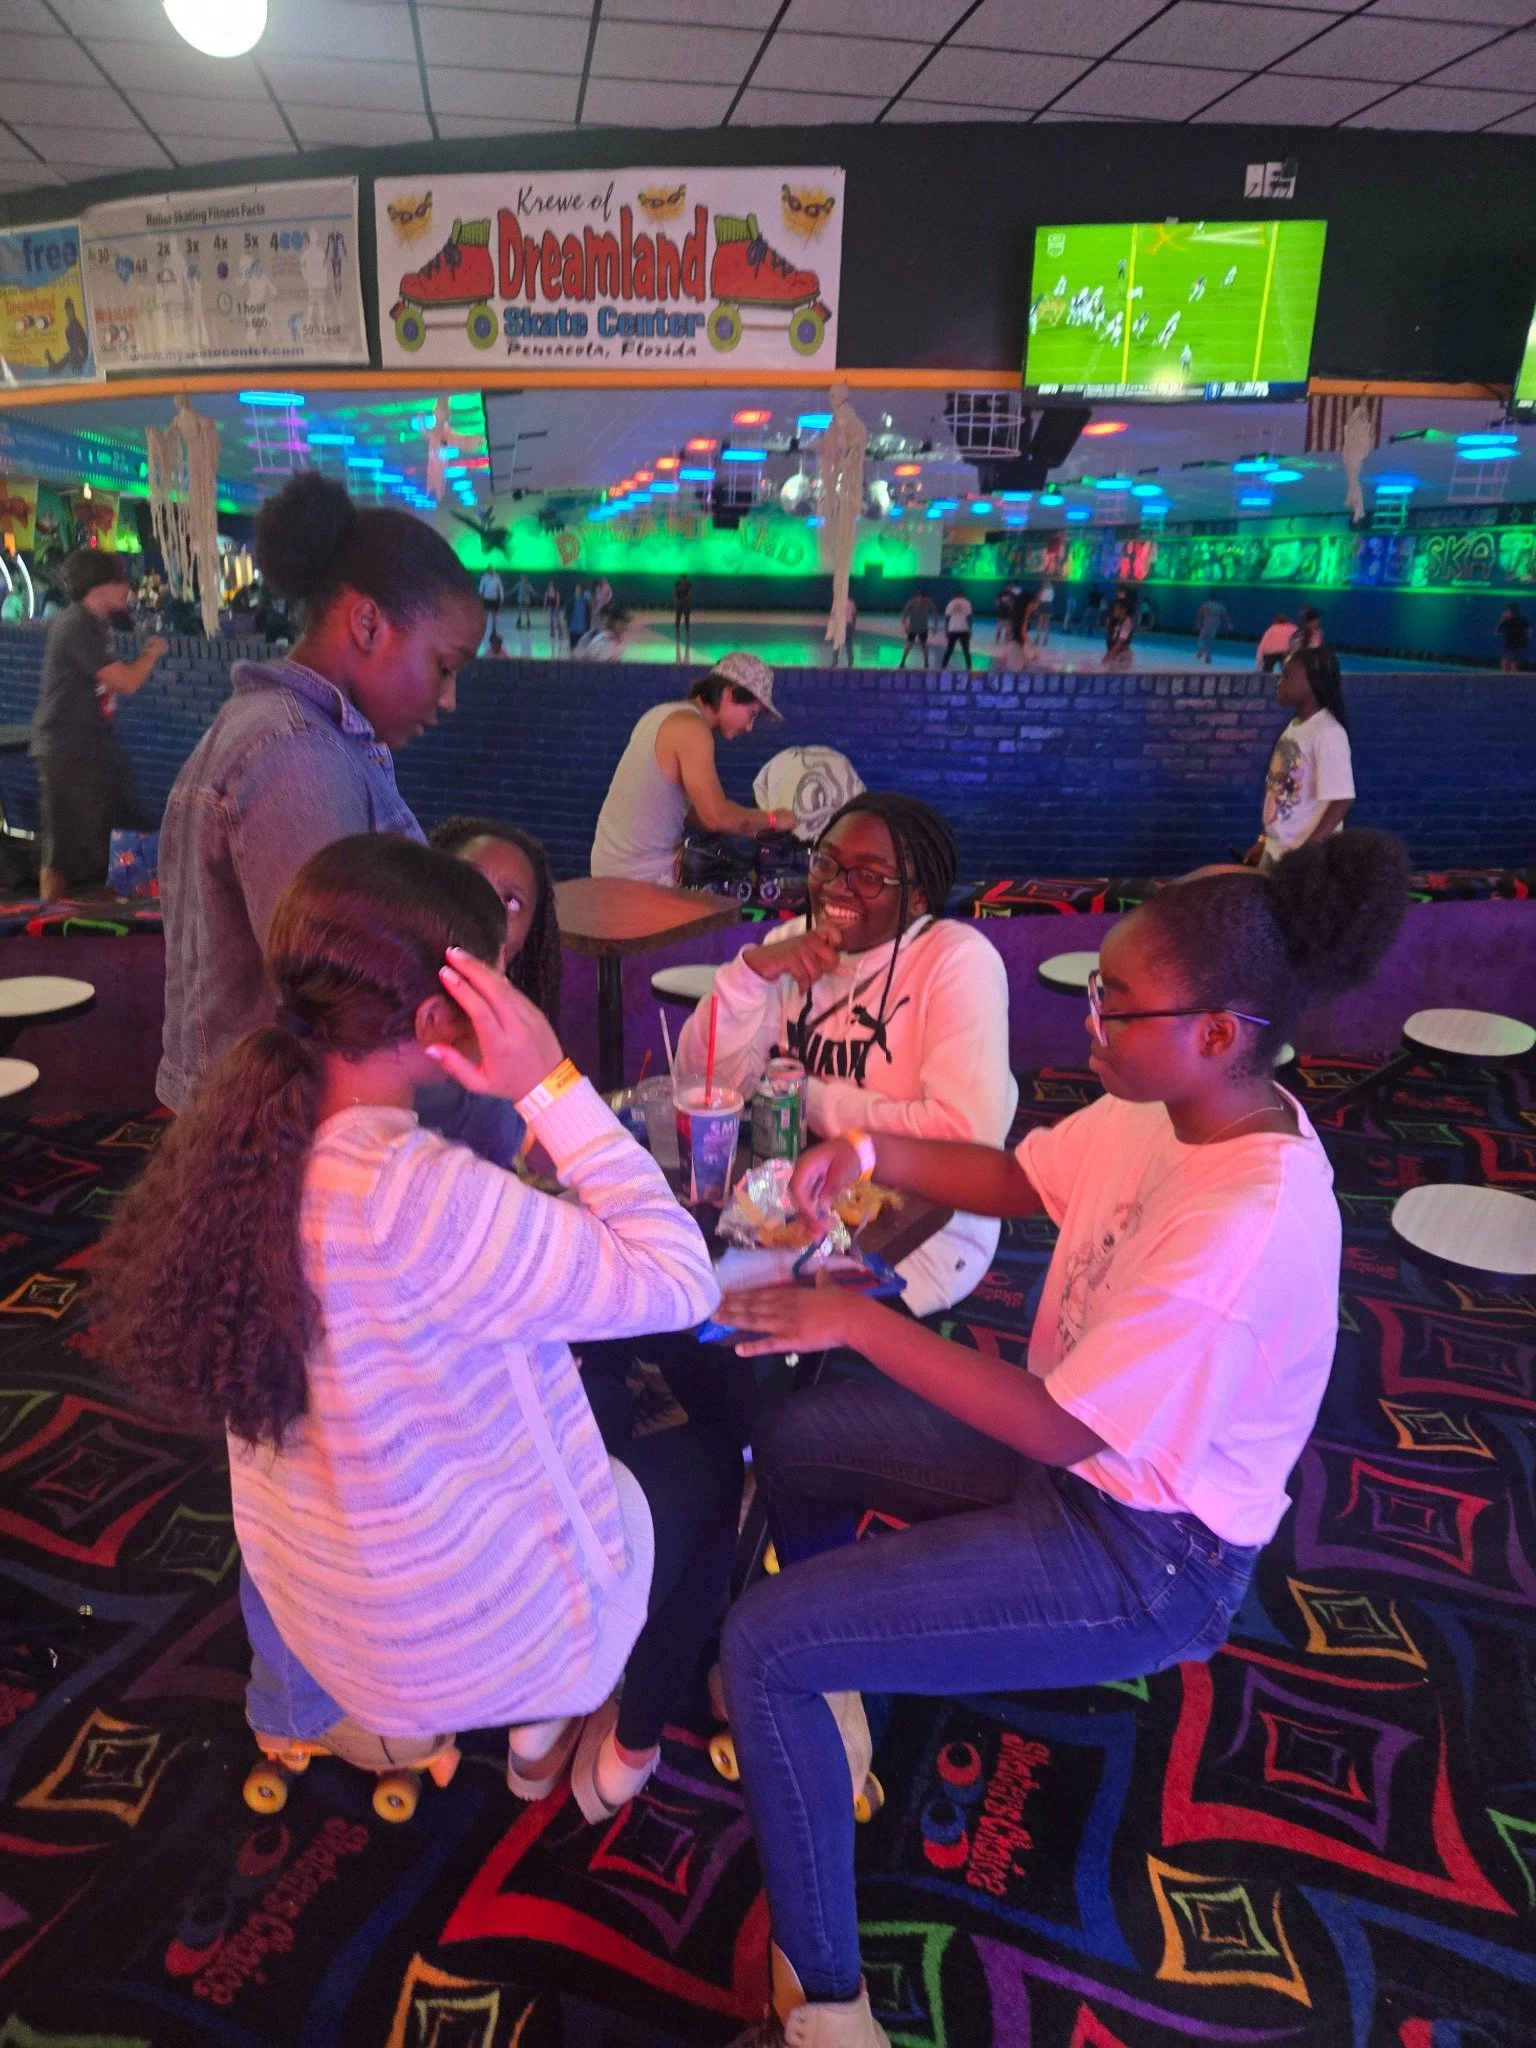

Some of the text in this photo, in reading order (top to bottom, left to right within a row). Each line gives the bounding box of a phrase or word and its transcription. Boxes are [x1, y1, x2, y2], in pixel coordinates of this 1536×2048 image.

[516, 180, 615, 223] Krewe of
[173, 208, 208, 224] Skating
[208, 205, 240, 219] Fitness
[241, 202, 265, 216] Facts
[213, 234, 229, 251] 4x
[244, 231, 260, 249] 5x
[23, 233, 78, 272] free
[497, 203, 709, 303] Dreamland
[243, 301, 267, 315] hour
[503, 305, 706, 339] Skate Center
[621, 341, 697, 358] Florida
